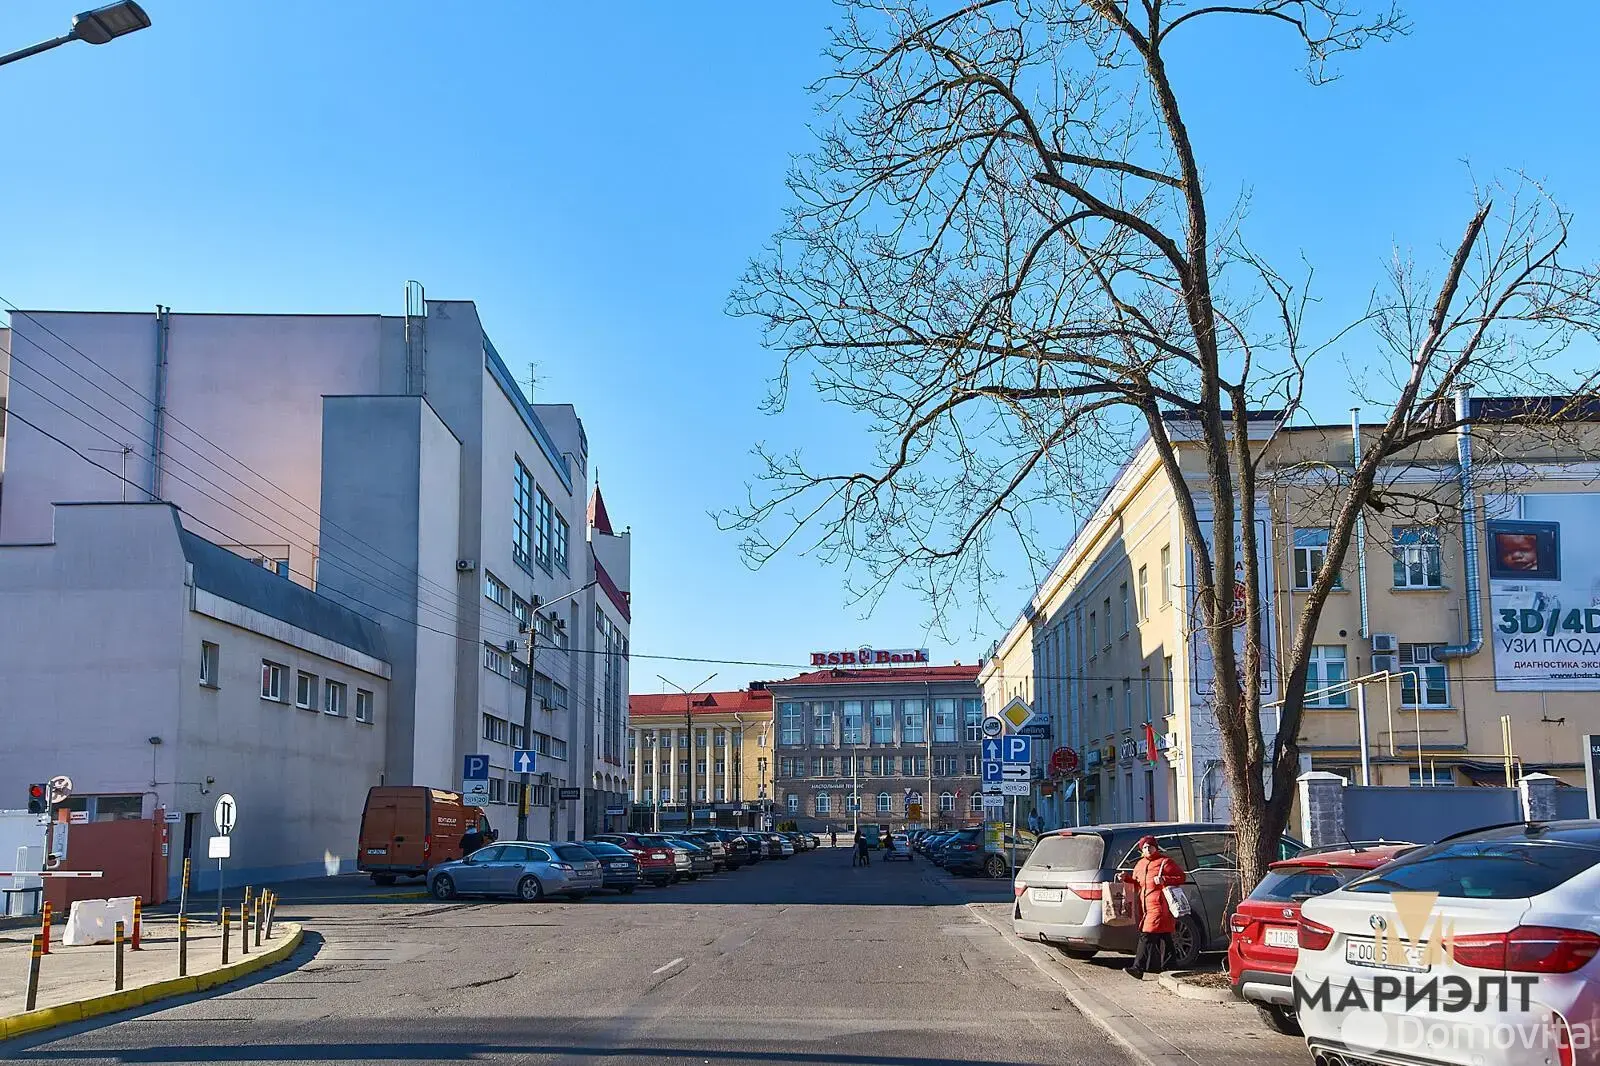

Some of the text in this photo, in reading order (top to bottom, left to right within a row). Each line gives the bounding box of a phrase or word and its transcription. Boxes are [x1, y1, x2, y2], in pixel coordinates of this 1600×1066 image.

[1498, 608, 1600, 637] 3D/4D
[1502, 638, 1537, 653] УЗИ
[810, 649, 928, 666] BSB Bank
[1513, 661, 1600, 669] ДИАГНОСТИКА ЭКС
[1010, 738, 1026, 760] P
[470, 757, 484, 777] P
[987, 763, 999, 780] P
[1358, 944, 1387, 962] 006
